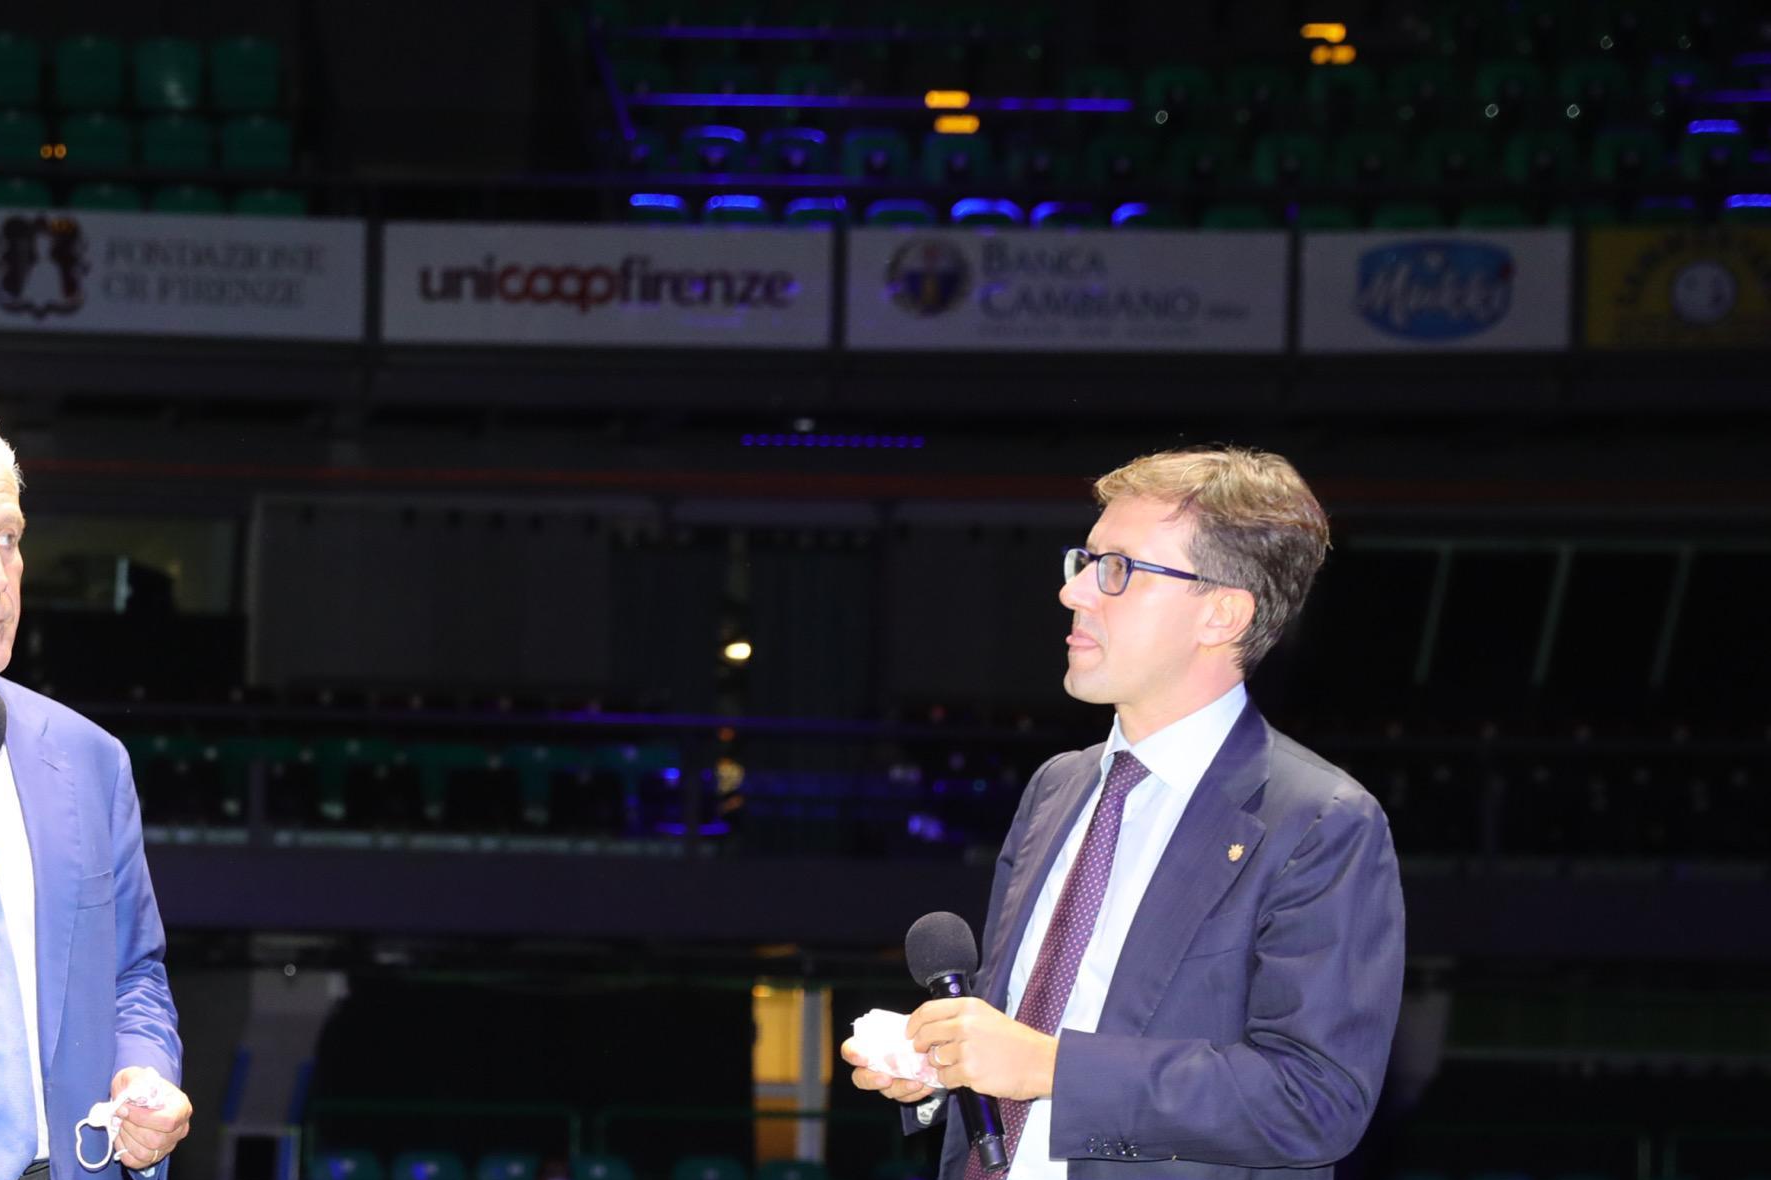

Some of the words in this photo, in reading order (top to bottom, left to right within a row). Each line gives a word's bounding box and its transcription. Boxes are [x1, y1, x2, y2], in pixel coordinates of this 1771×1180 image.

[106, 238, 324, 275] FONDAZIONE
[157, 276, 306, 308] FIRENZE
[419, 252, 795, 313] unicoopfirenze
